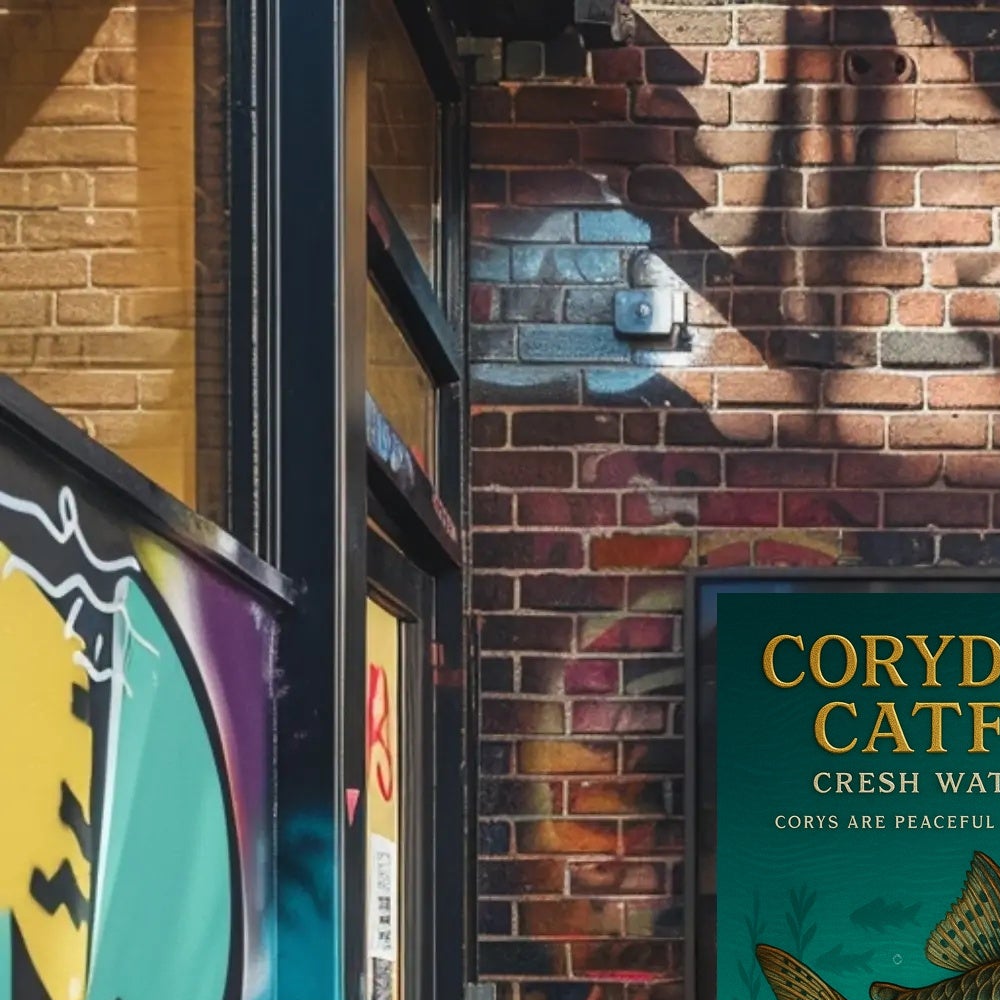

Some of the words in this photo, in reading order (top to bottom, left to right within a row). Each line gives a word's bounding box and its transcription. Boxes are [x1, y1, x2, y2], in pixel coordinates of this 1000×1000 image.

[813, 771, 919, 794] CRESH
[774, 815, 839, 829] CORYS
[847, 815, 886, 829] ARE
[895, 815, 995, 829] PEACEFUL
